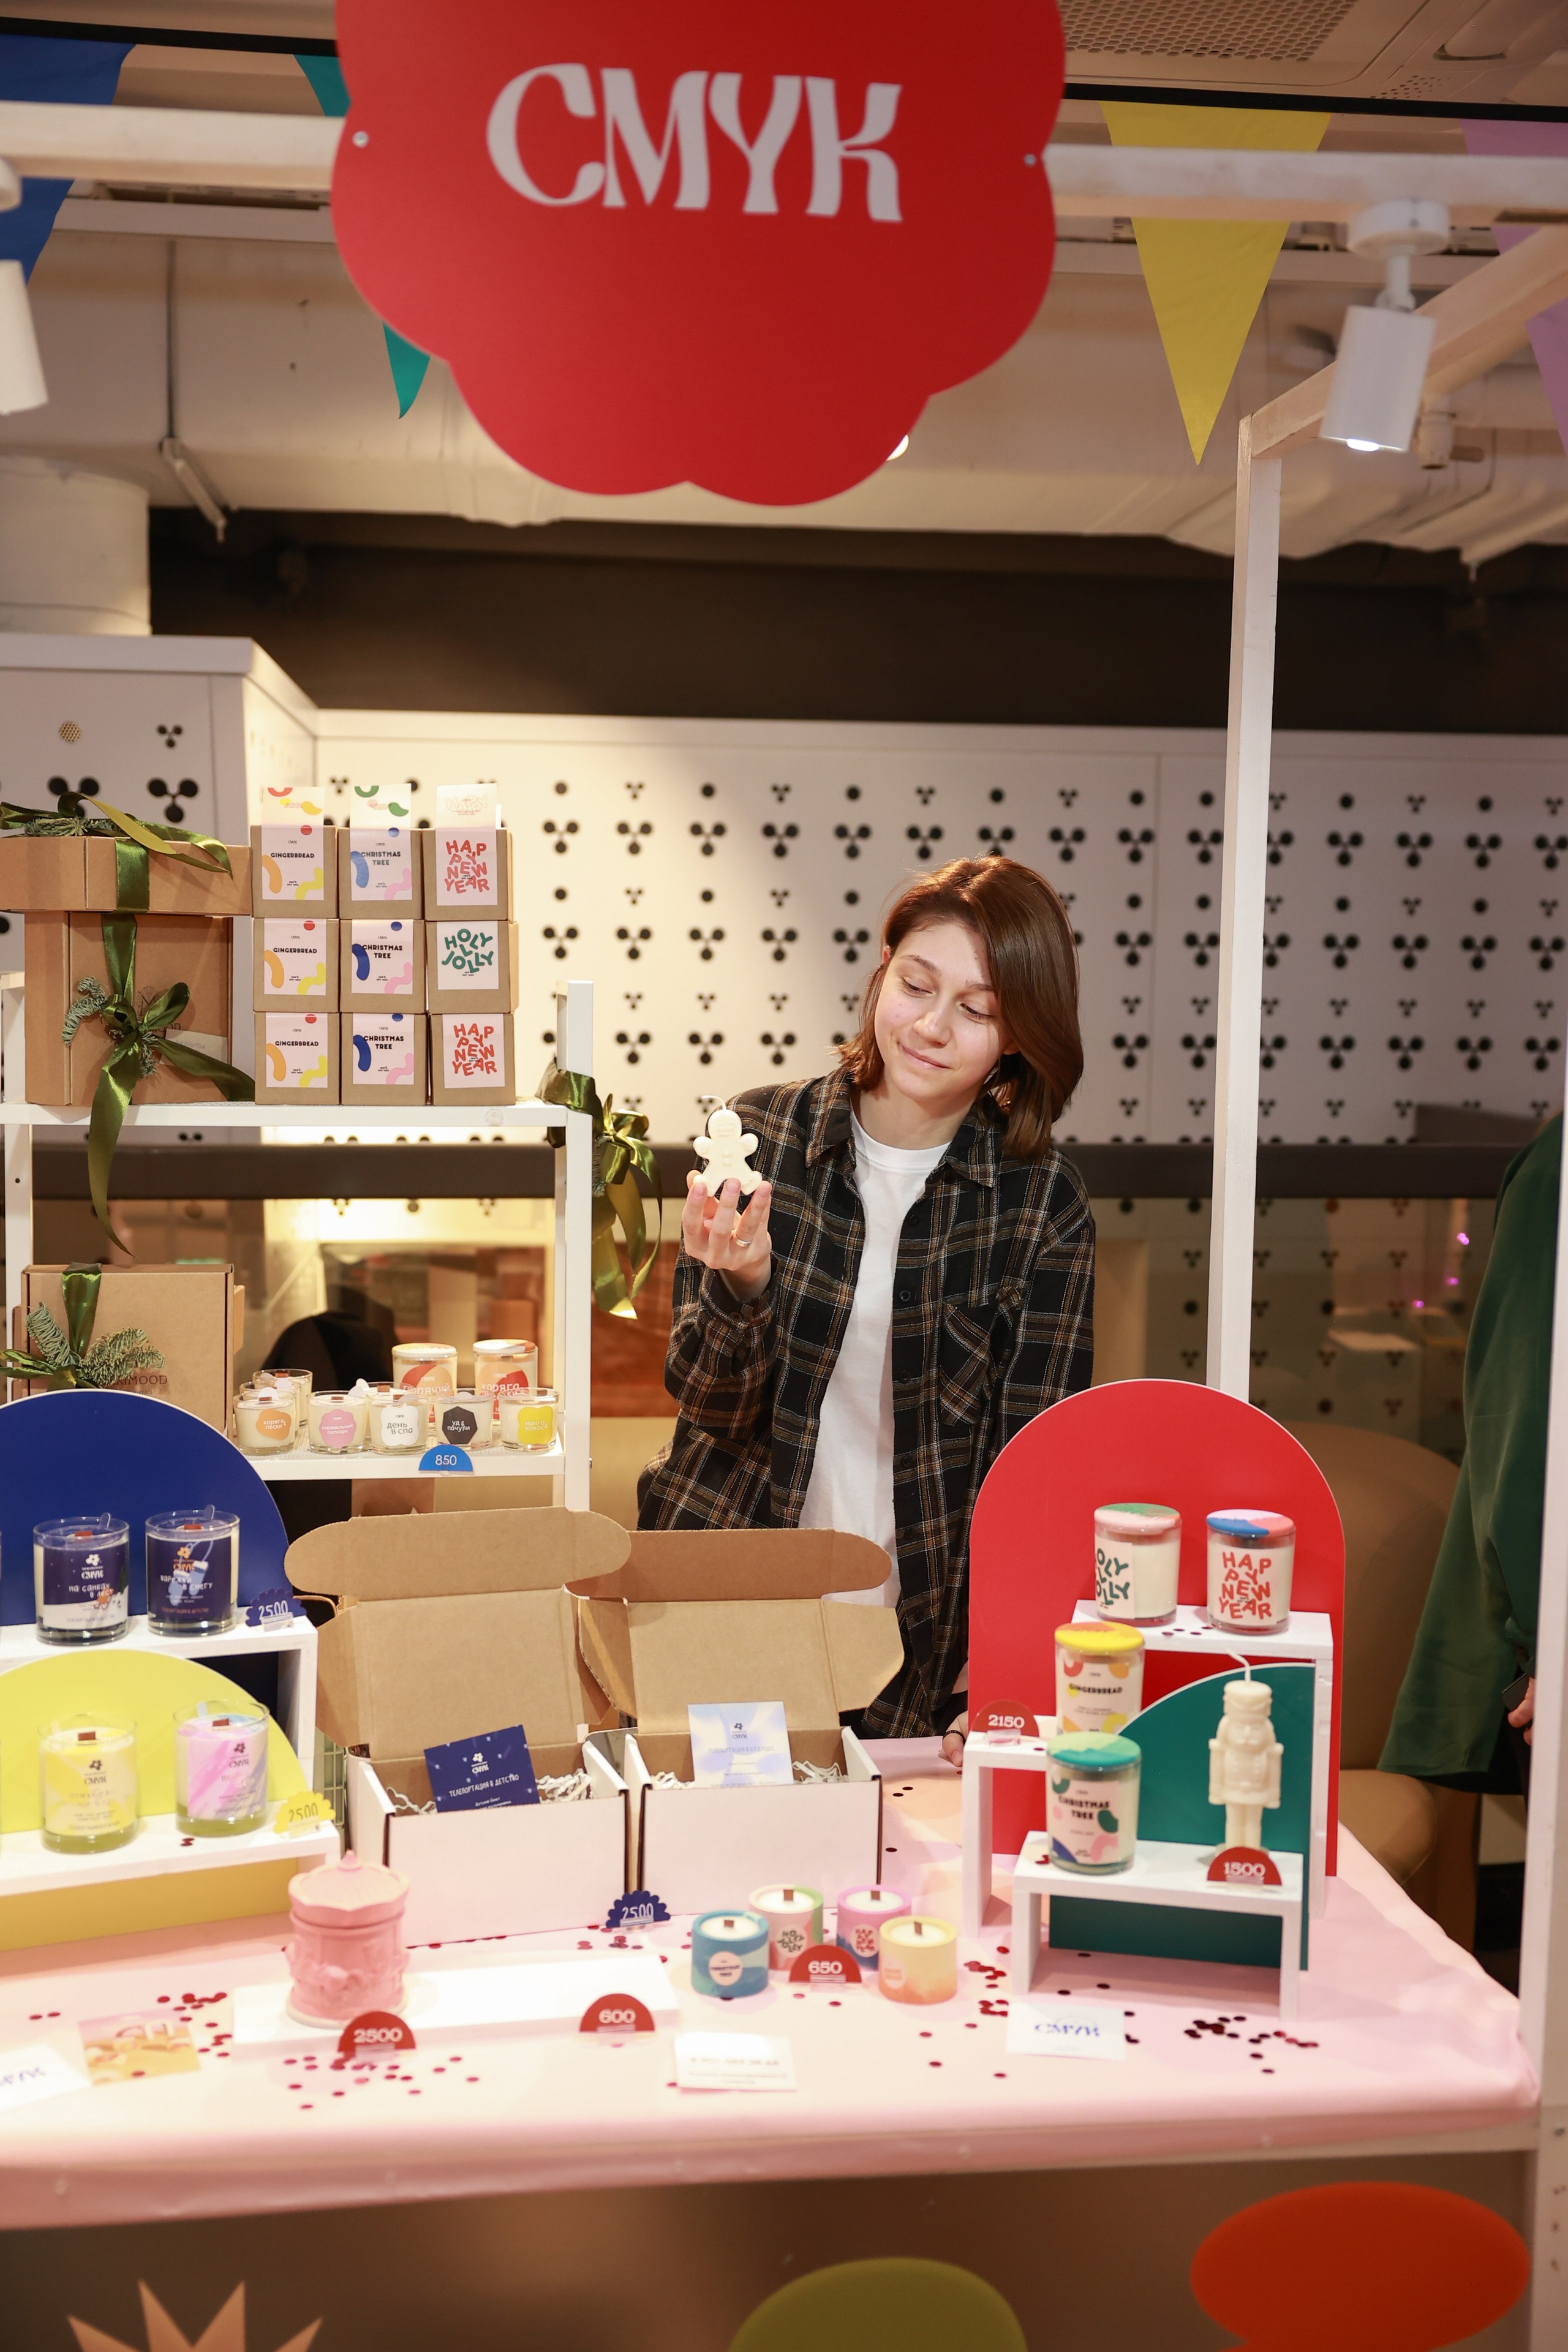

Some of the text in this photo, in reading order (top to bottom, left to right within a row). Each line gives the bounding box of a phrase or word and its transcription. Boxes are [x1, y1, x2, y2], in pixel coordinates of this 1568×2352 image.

[486, 62, 903, 222] CMYK
[446, 840, 487, 856] HAP
[447, 861, 488, 880] NEW
[445, 875, 490, 894] YEAR
[442, 951, 494, 973] JOLLY
[453, 1023, 494, 1039] HAP
[454, 1044, 495, 1062] NEW
[452, 1058, 497, 1076] YEAR
[435, 1454, 457, 1466] 850
[1223, 1552, 1272, 1574] HAP
[1096, 1580, 1129, 1605] OLLY
[1222, 1580, 1270, 1601] NEW
[258, 1600, 288, 1621] 2500
[1219, 1596, 1272, 1619] YEAR
[988, 1714, 1025, 1728] 2150
[448, 1781, 490, 1798] ТЕЛЕПОРТАЦИЯ
[494, 1774, 519, 1786] ДЕТСТВО
[289, 1803, 318, 1823] 2500
[1224, 1862, 1266, 1877] 1500
[622, 1902, 654, 1920] 2500
[808, 1960, 843, 1974] 650
[598, 2008, 636, 2024] 600
[353, 2027, 403, 2043] 2500
